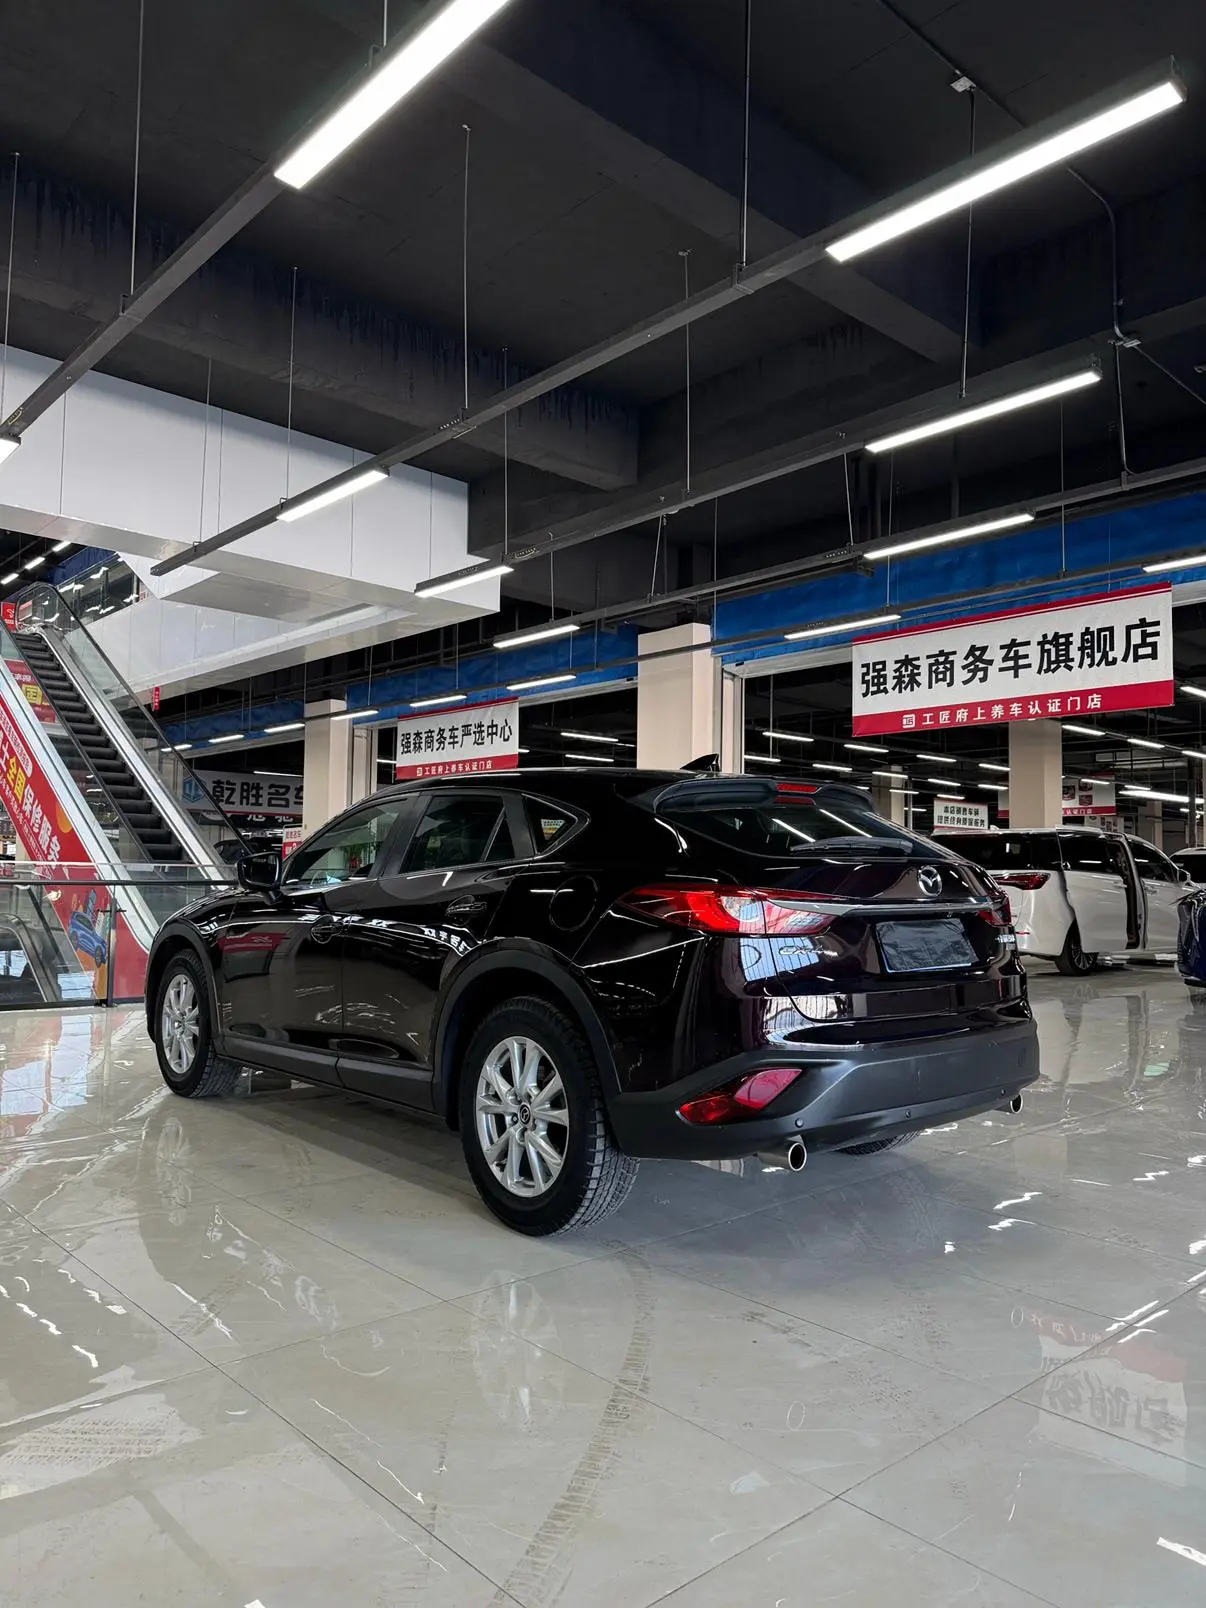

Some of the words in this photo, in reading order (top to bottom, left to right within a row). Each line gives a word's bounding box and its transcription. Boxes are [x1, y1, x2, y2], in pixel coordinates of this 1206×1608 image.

[861, 617, 1161, 698] 强森商务车旗舰店
[922, 693, 1102, 726] 工匠府上养车认证门店
[401, 719, 512, 755] 强森商务车严选中心
